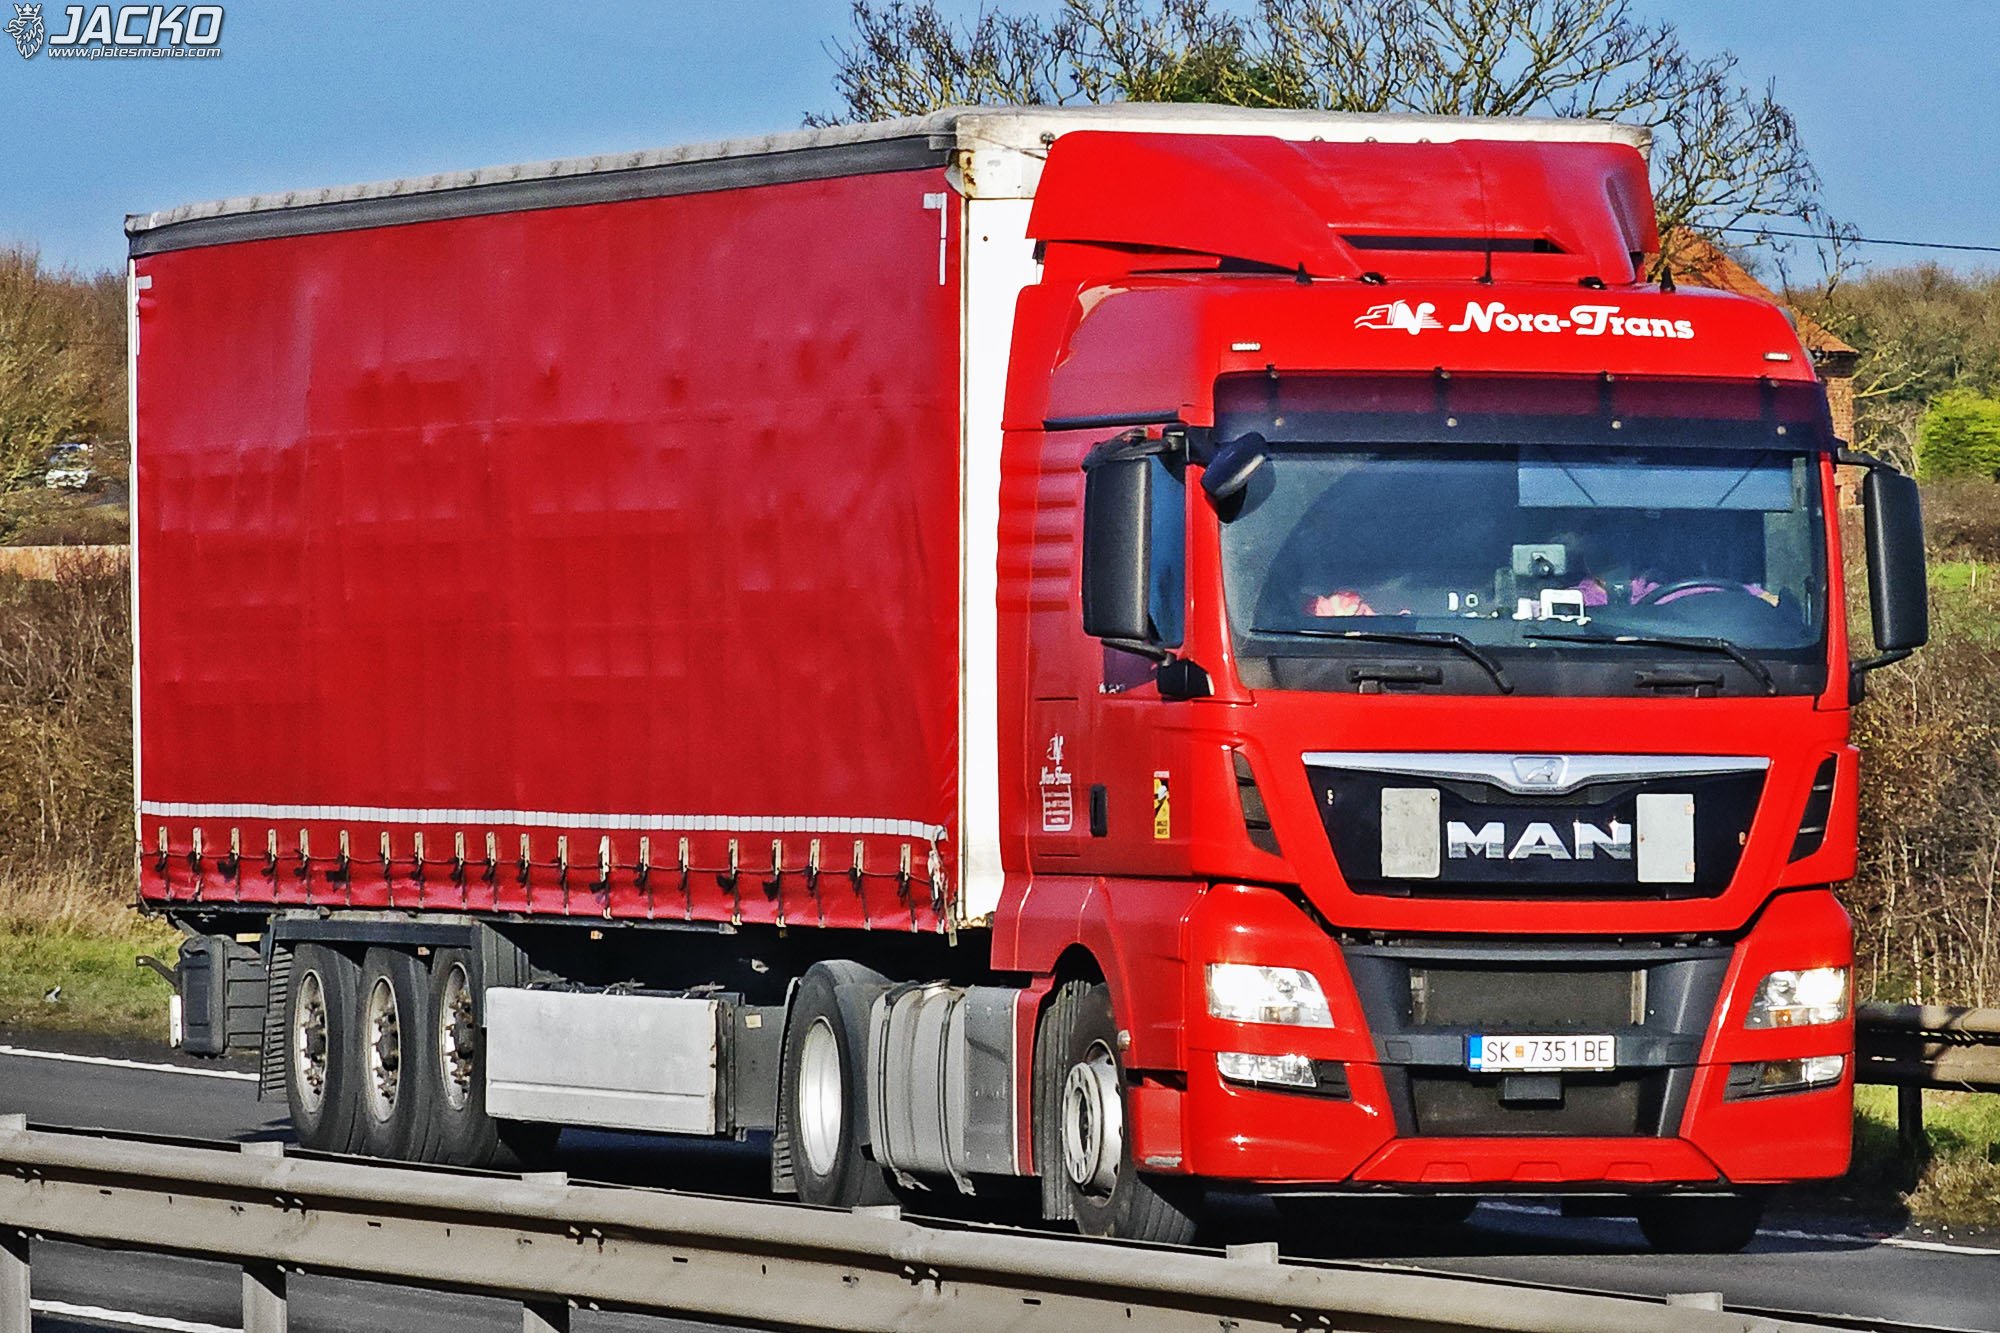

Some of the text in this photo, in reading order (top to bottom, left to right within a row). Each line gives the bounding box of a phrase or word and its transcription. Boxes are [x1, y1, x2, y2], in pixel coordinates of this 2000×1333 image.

[1448, 301, 1695, 339] Nora-Trans
[1447, 821, 1632, 860] MAN
[1486, 1041, 1511, 1063] SK
